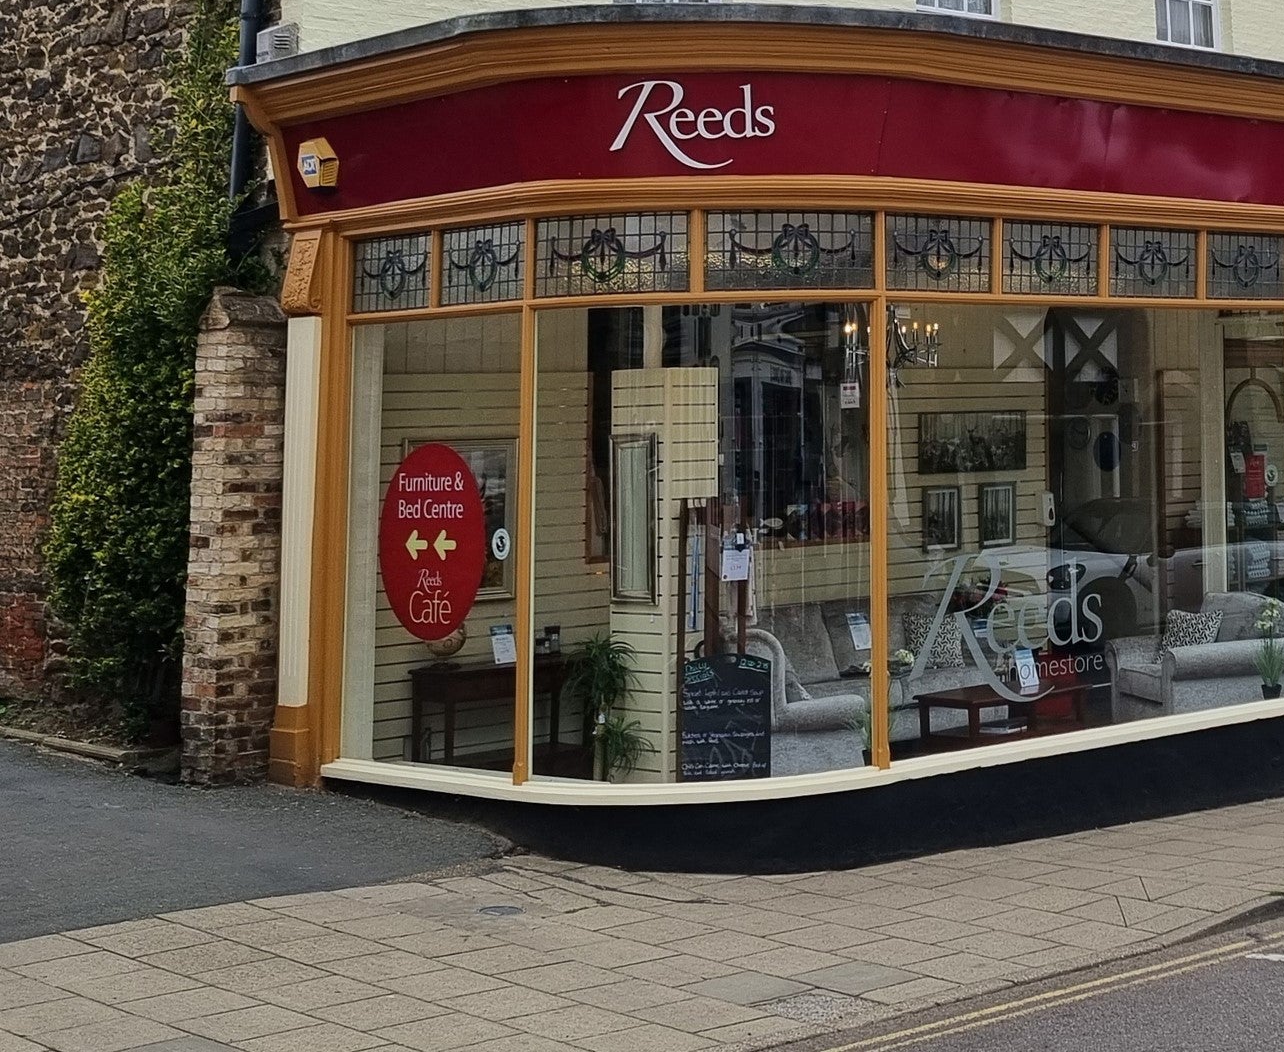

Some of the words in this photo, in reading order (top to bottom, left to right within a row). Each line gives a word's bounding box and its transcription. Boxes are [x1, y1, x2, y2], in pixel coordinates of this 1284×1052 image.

[609, 80, 776, 169] Reeds
[399, 472, 452, 492] Furniture
[454, 471, 464, 491] &
[399, 500, 420, 519] Bed
[423, 499, 464, 519] Centre
[417, 568, 442, 593] Reeds
[409, 590, 452, 625] Café
[908, 553, 1103, 703] Reeds
[1008, 653, 1104, 681] homestore
